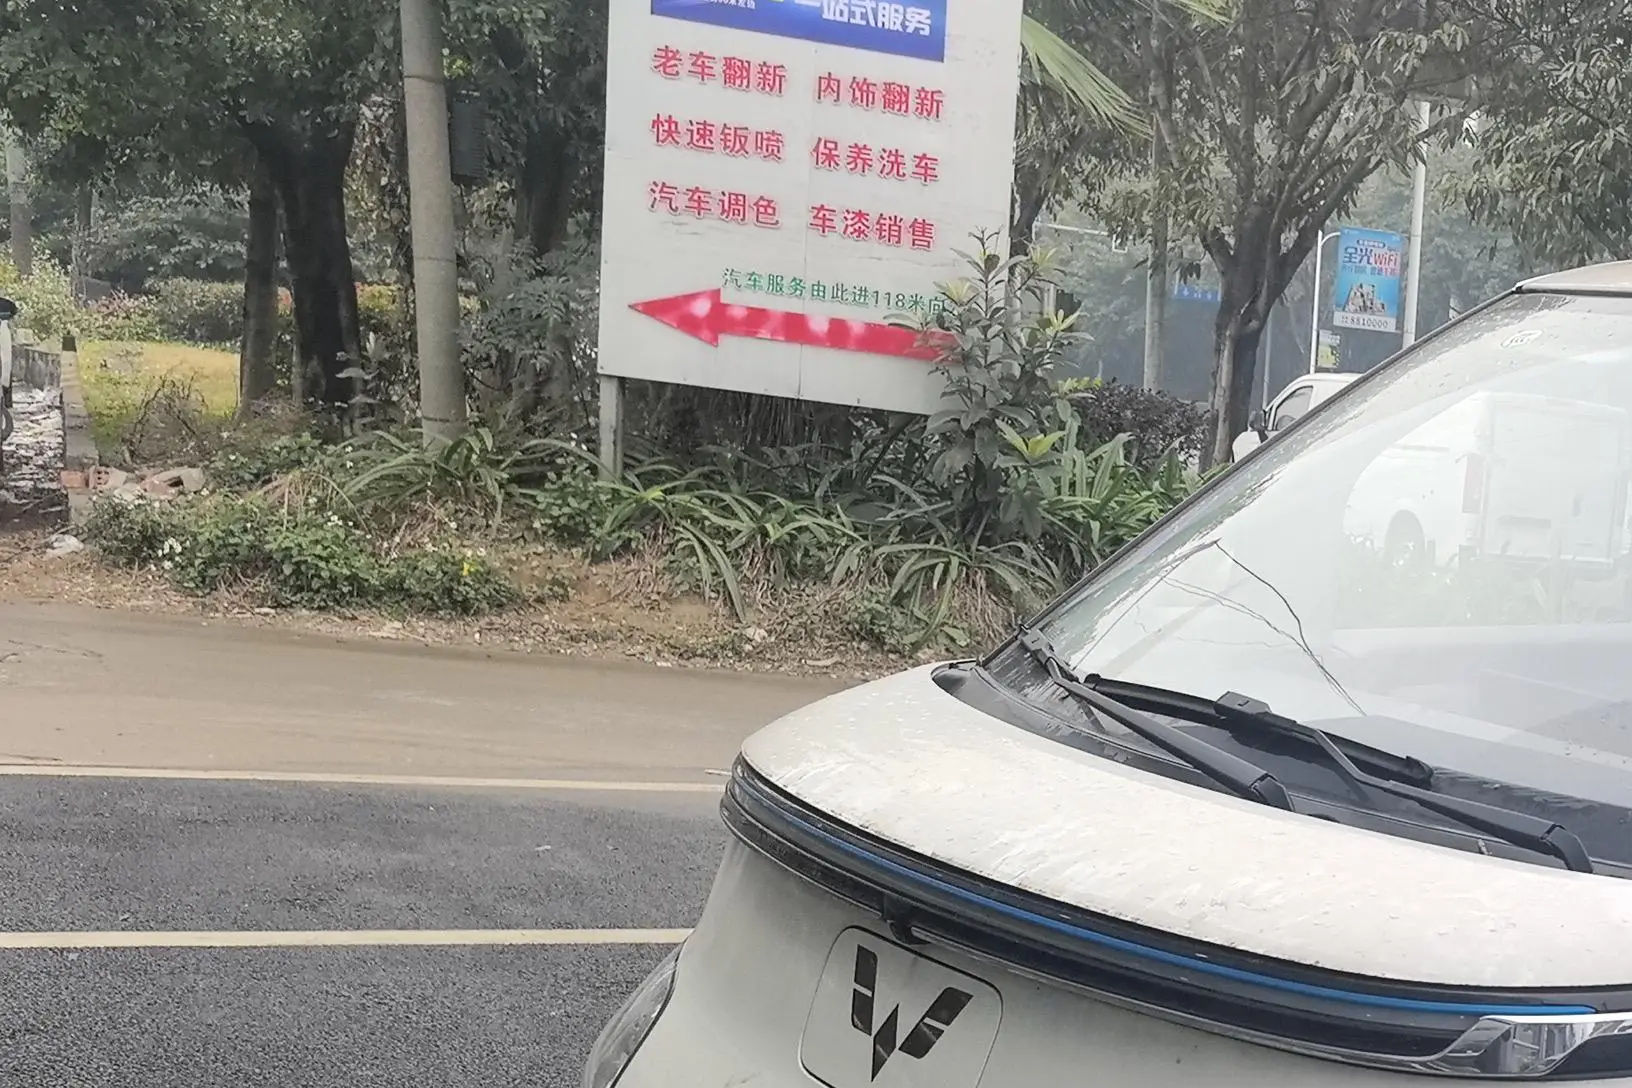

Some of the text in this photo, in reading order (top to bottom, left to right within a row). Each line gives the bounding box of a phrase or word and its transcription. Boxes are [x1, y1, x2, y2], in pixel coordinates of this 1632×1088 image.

[653, 46, 944, 119] 老车翻新 内饰翻新
[651, 114, 939, 183] 快速钣喷 保养洗车
[649, 181, 936, 250] 汽车调色 车漆销售
